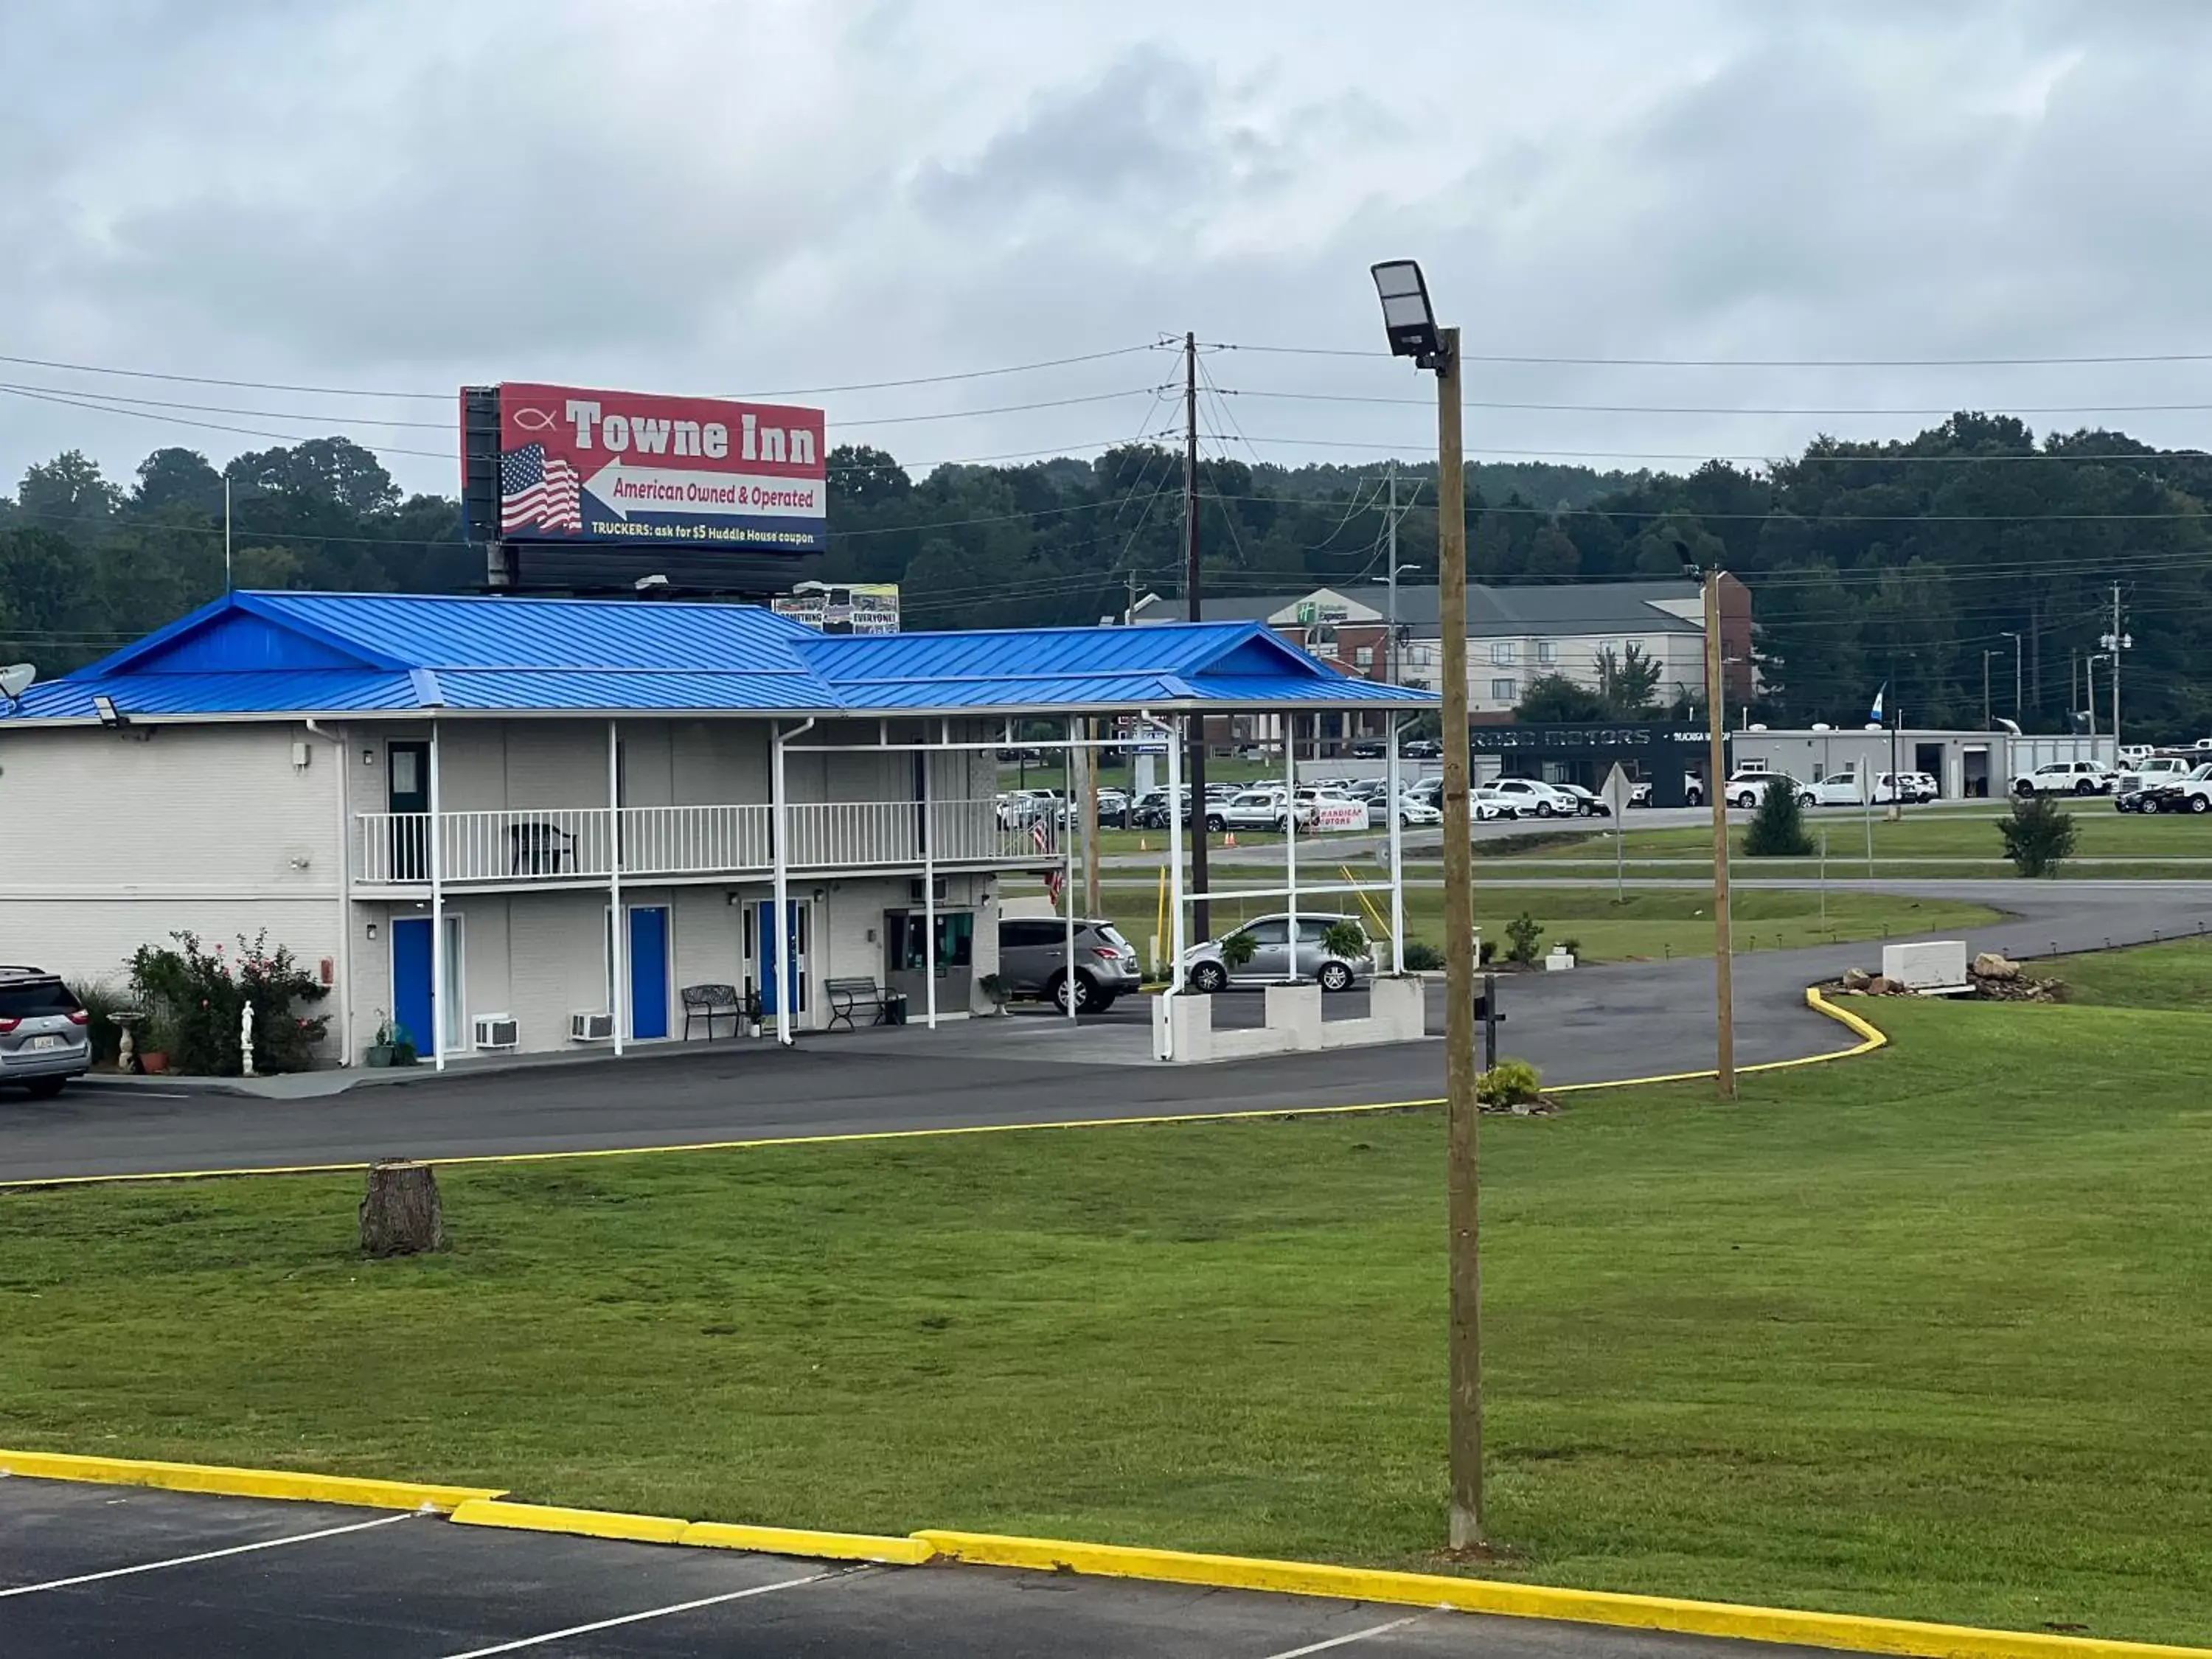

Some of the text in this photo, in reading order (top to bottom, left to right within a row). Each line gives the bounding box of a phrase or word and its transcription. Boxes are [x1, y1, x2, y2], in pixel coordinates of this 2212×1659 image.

[566, 400, 815, 465] Towne Inn
[613, 477, 813, 510] American Owned & Operated
[591, 521, 815, 546] TRUCKERS: ask for $5 Huddle House coupon
